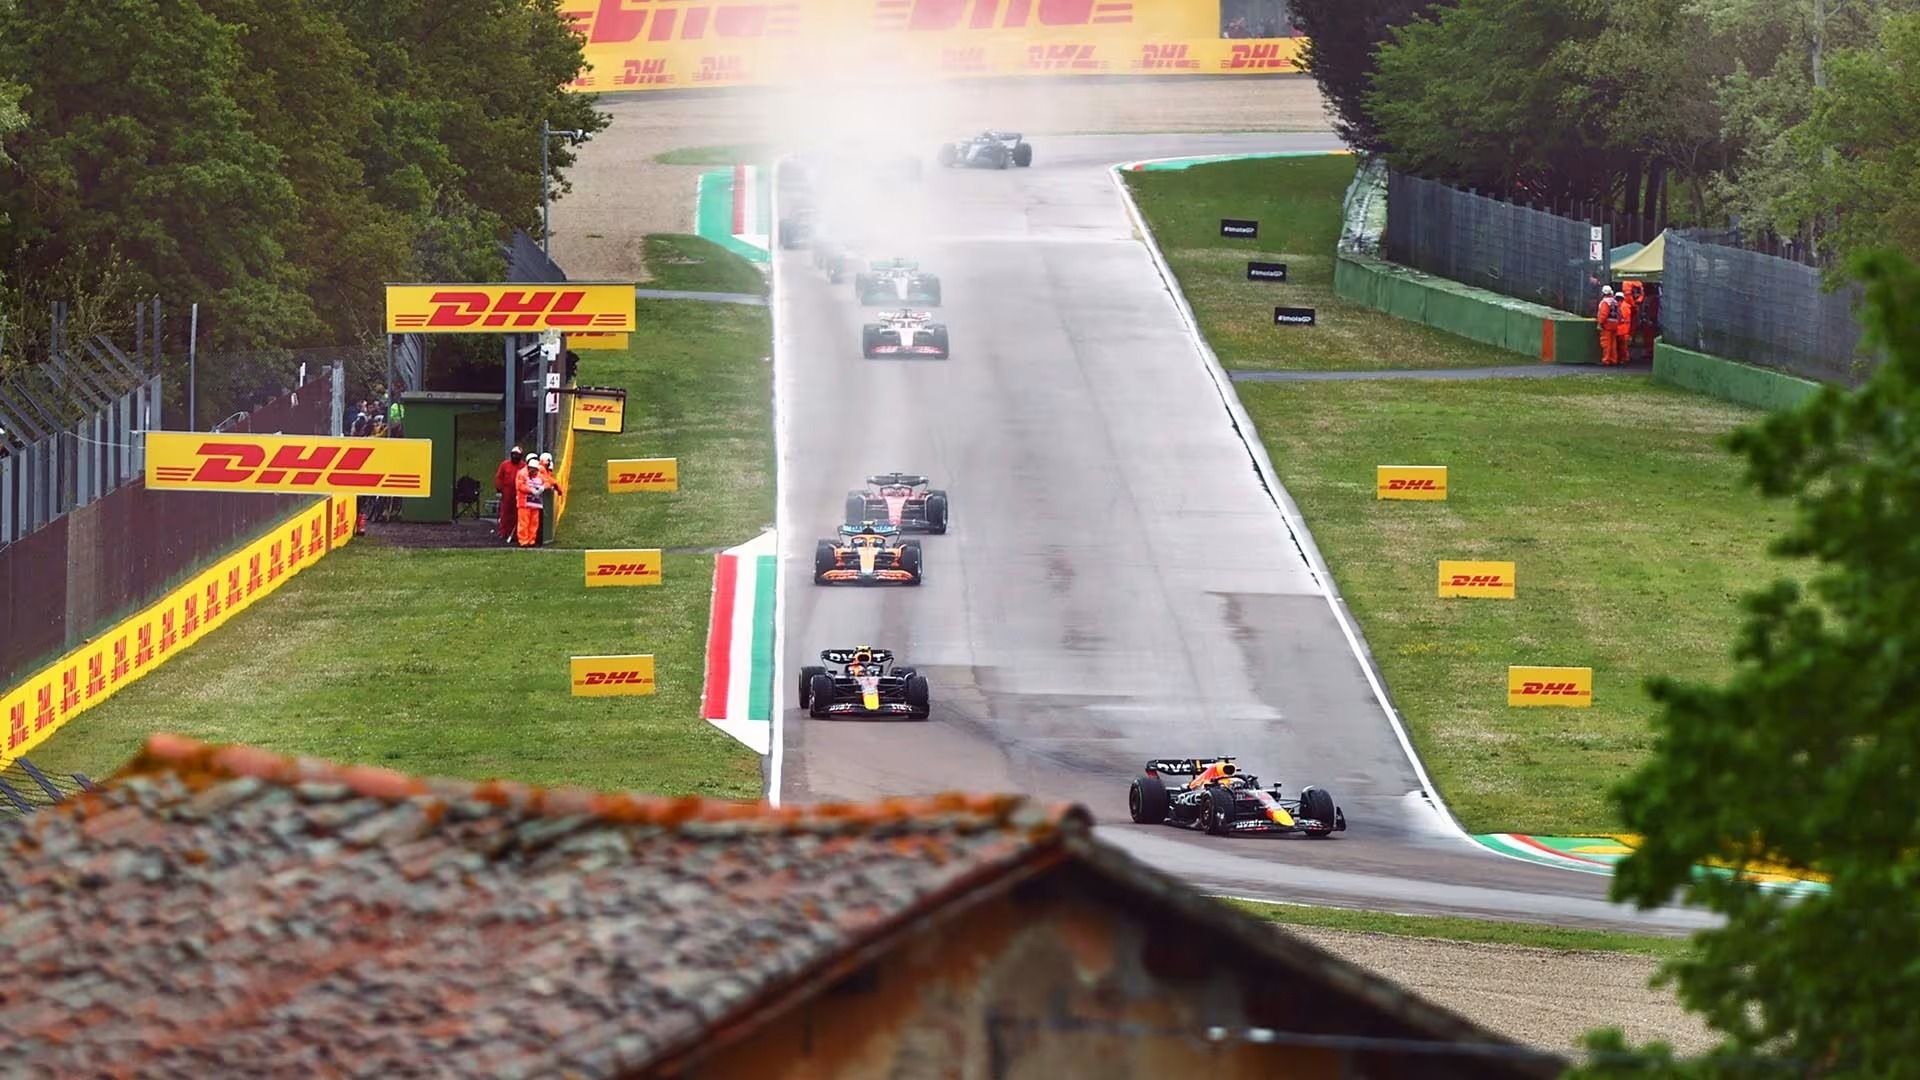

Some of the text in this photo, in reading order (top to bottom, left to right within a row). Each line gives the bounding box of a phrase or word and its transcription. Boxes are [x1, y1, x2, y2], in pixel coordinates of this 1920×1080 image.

[1141, 44, 1191, 68] DHL
[1231, 44, 1280, 68] DHL
[623, 59, 668, 84] DHL
[426, 291, 596, 326] DHL
[583, 403, 615, 414] DHL
[192, 442, 386, 487] DHL
[618, 472, 667, 484] DHL
[1388, 479, 1436, 490] DHL
[597, 563, 649, 576] DHL
[1451, 575, 1503, 587] DHL
[585, 671, 642, 685] DHL
[1521, 682, 1579, 695] DHL
